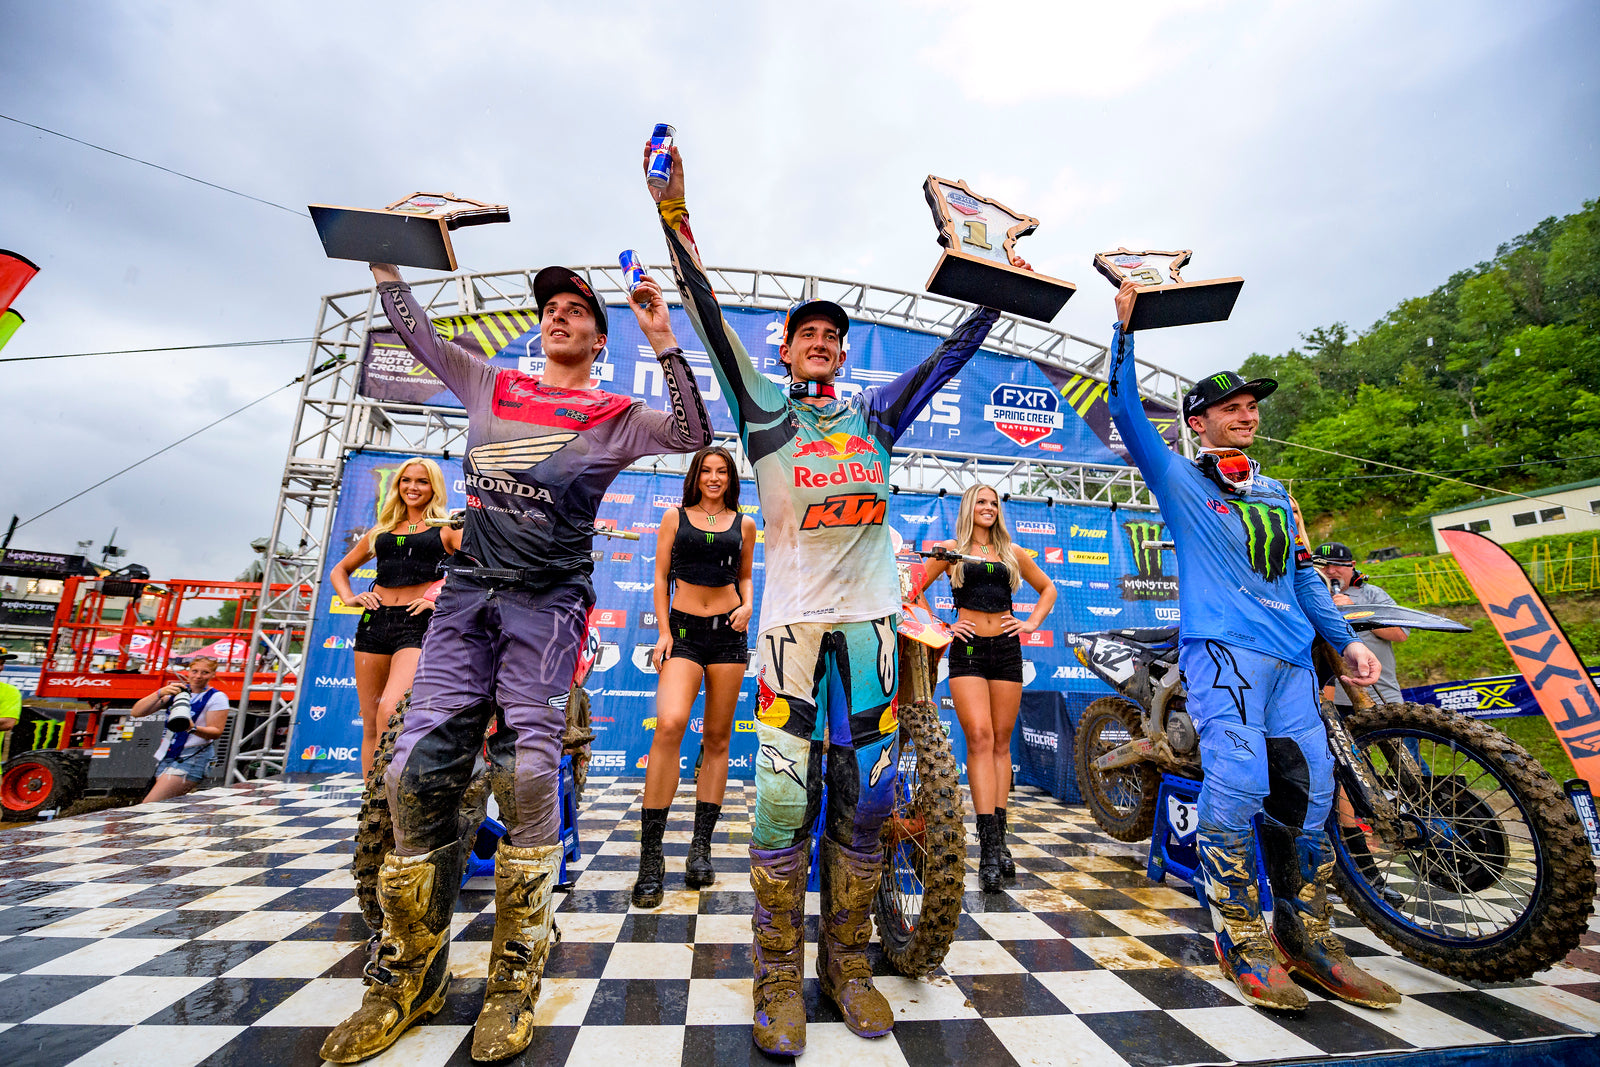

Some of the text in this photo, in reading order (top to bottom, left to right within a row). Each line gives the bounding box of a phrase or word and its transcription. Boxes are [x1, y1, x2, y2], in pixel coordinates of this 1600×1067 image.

[963, 221, 992, 250] 1
[388, 286, 417, 334] NDA
[373, 356, 413, 365] MOTO
[369, 363, 413, 373] CROSS
[368, 373, 395, 381] WORLD
[662, 358, 690, 437] HONDA
[1003, 389, 1049, 409] FXR
[993, 409, 1055, 425] SPRING CREEK
[1002, 424, 1046, 433] NATIONAL
[793, 461, 885, 488] Red Bull
[466, 474, 554, 504] HONDA
[487, 505, 521, 514] DUNLOP
[738, 505, 758, 513] HOR
[800, 493, 886, 530] KTM
[1016, 521, 1055, 531] PARTS
[1078, 529, 1107, 538] THOR
[1124, 580, 1179, 590] MONSTER
[1092, 643, 1132, 673] 32
[48, 676, 112, 687] SKYJACK
[1436, 690, 1479, 700] SUPER
[1441, 696, 1479, 705] MOTO
[327, 747, 358, 760] NBC
[1176, 804, 1189, 832] 3
